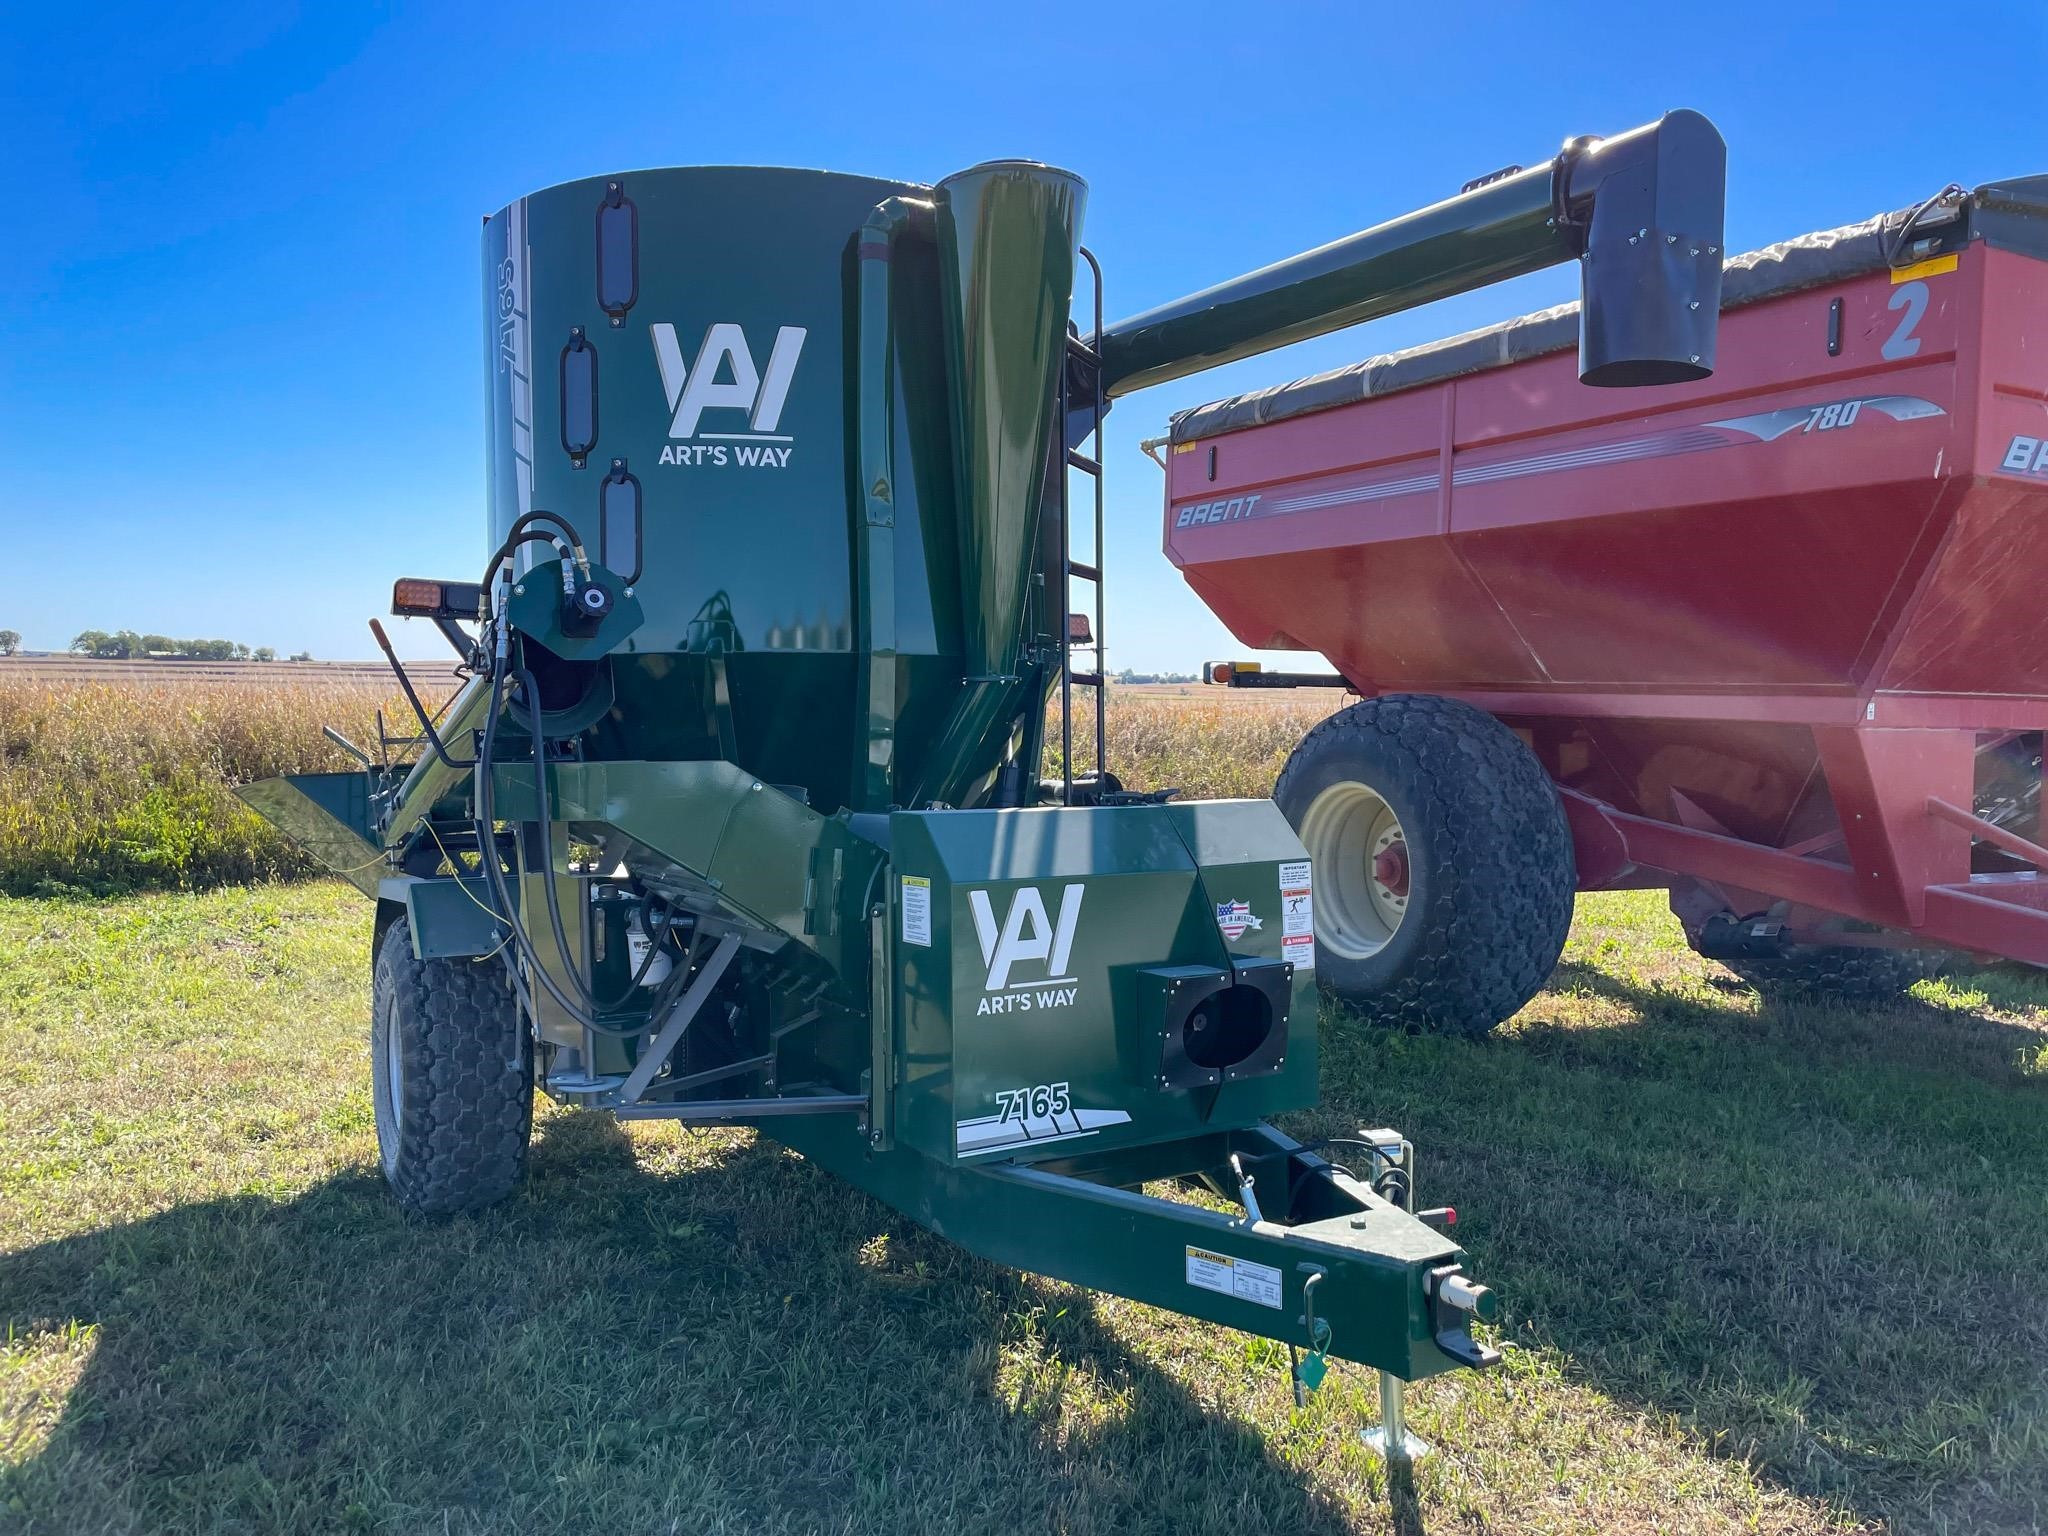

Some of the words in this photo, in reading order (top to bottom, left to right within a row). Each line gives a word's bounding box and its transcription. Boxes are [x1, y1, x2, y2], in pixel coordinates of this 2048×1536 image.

[498, 257, 516, 373] 7165
[1881, 281, 1929, 360] 2
[1804, 400, 1862, 433] 780
[658, 445, 728, 466] ART'S
[734, 446, 792, 468] WAY
[1175, 494, 1262, 528] BRENT
[976, 992, 1031, 1016] ART'S
[1036, 988, 1077, 1009] WAY
[995, 1081, 1069, 1124] 7165
[1200, 1252, 1227, 1264] CAUTION
